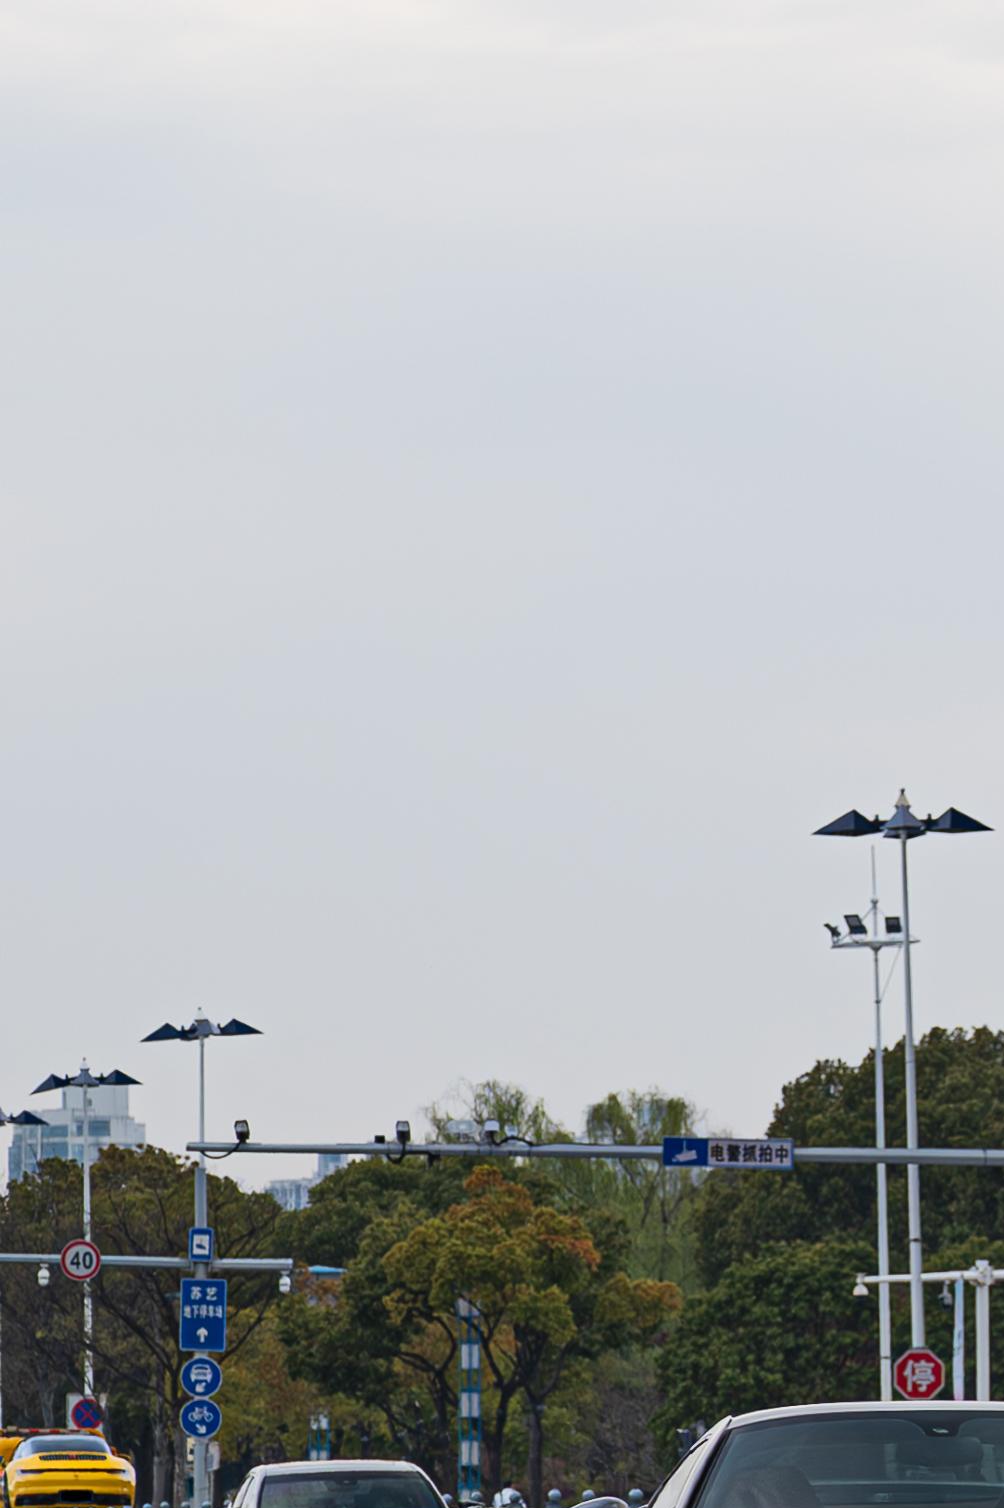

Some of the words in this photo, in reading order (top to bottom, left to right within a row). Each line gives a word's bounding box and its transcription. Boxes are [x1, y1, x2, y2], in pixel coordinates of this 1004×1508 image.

[710, 1144, 789, 1163] 电警抓拍中
[70, 1251, 93, 1270] 40
[903, 1360, 936, 1393] 停
